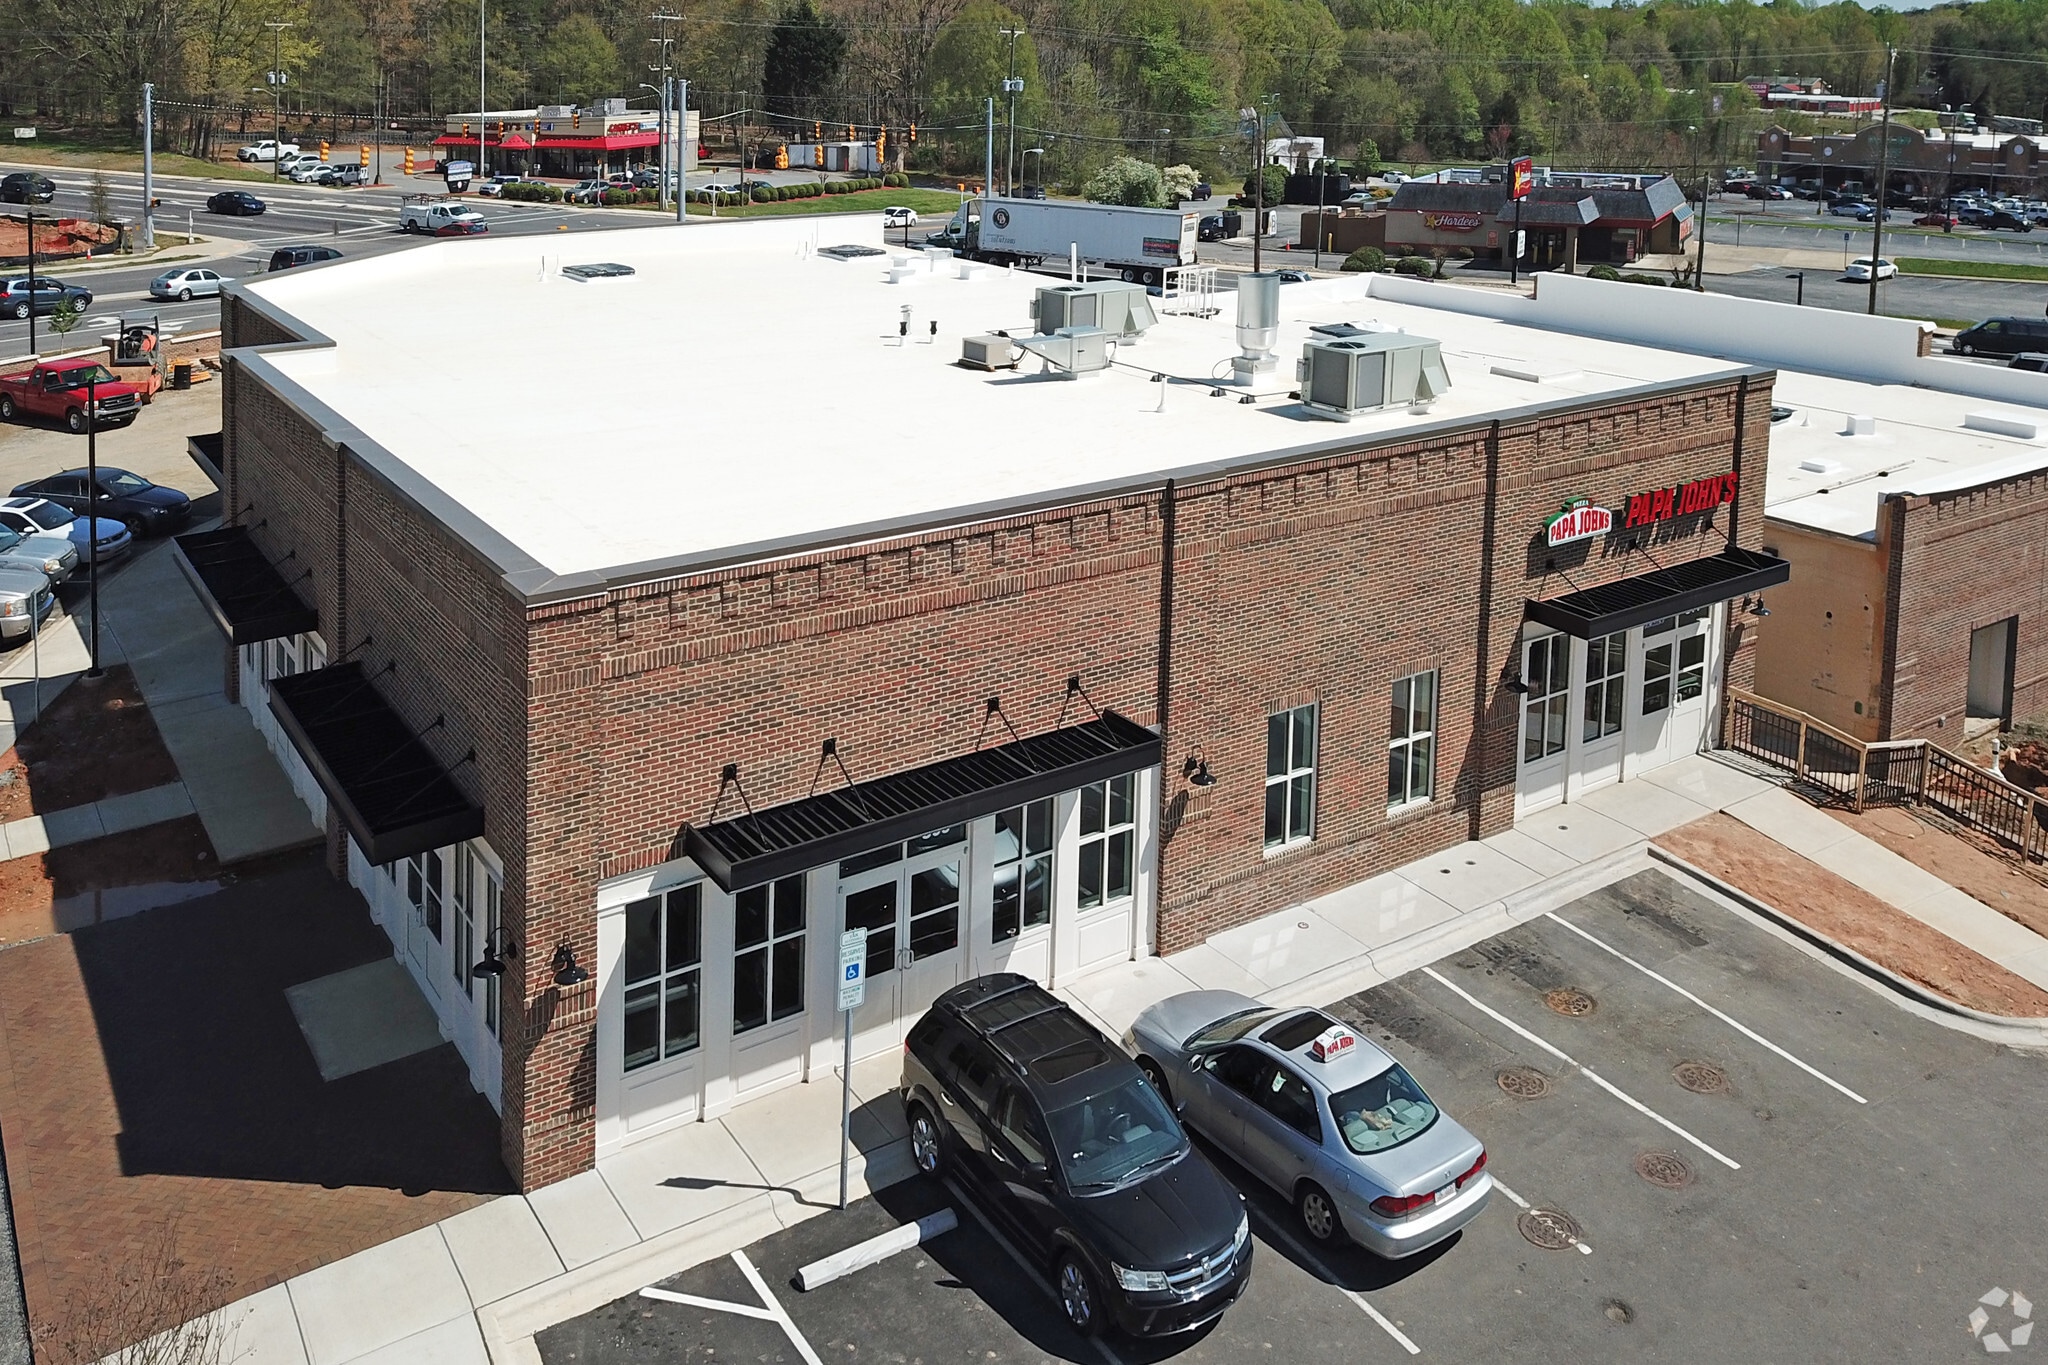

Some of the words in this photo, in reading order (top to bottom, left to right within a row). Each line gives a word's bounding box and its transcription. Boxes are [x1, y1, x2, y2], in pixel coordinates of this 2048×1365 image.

[1573, 500, 1589, 509] PIZZA
[1626, 487, 1675, 529] PAPA
[1677, 471, 1738, 516] JOHN'S
[1550, 513, 1576, 542] PAPA
